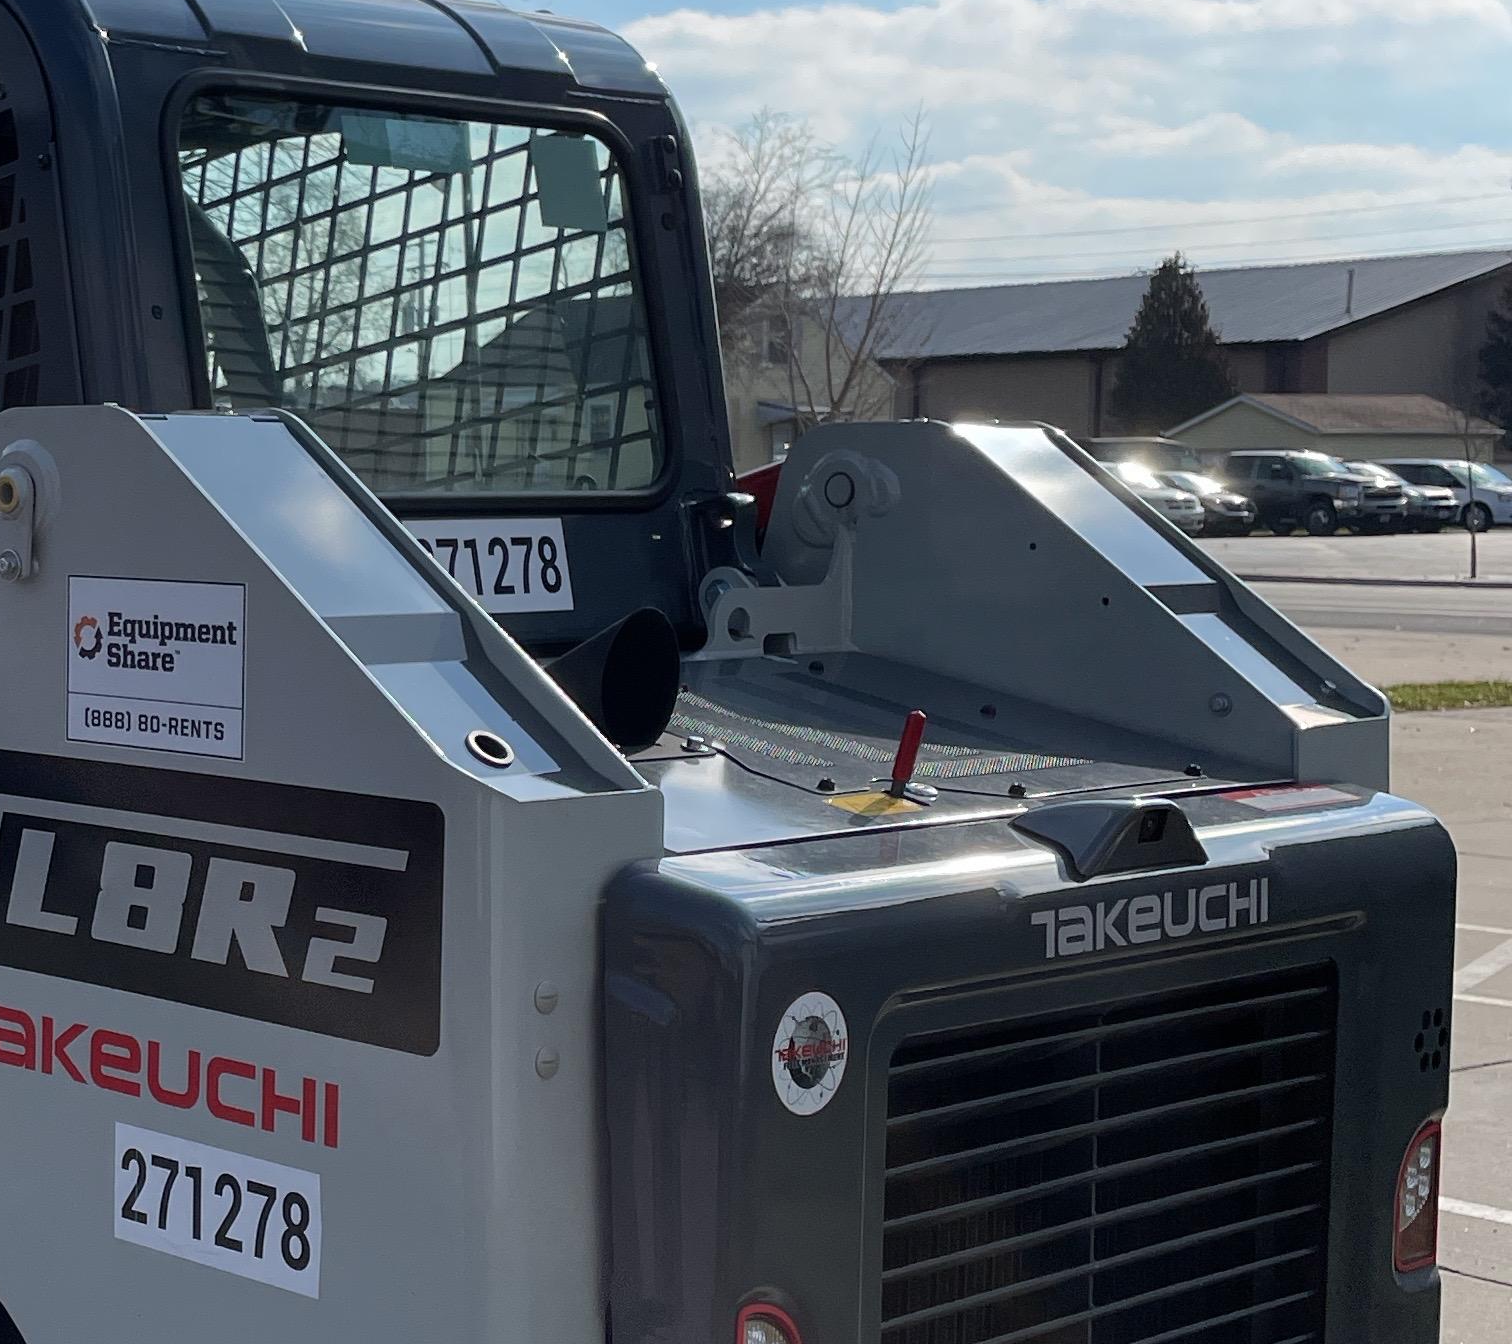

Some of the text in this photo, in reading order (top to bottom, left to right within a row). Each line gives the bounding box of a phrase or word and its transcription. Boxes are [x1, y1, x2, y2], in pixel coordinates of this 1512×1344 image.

[107, 611, 238, 646] Equipment
[84, 707, 225, 741] (888) 80-RENTS
[120, 1148, 311, 1271] 271278
